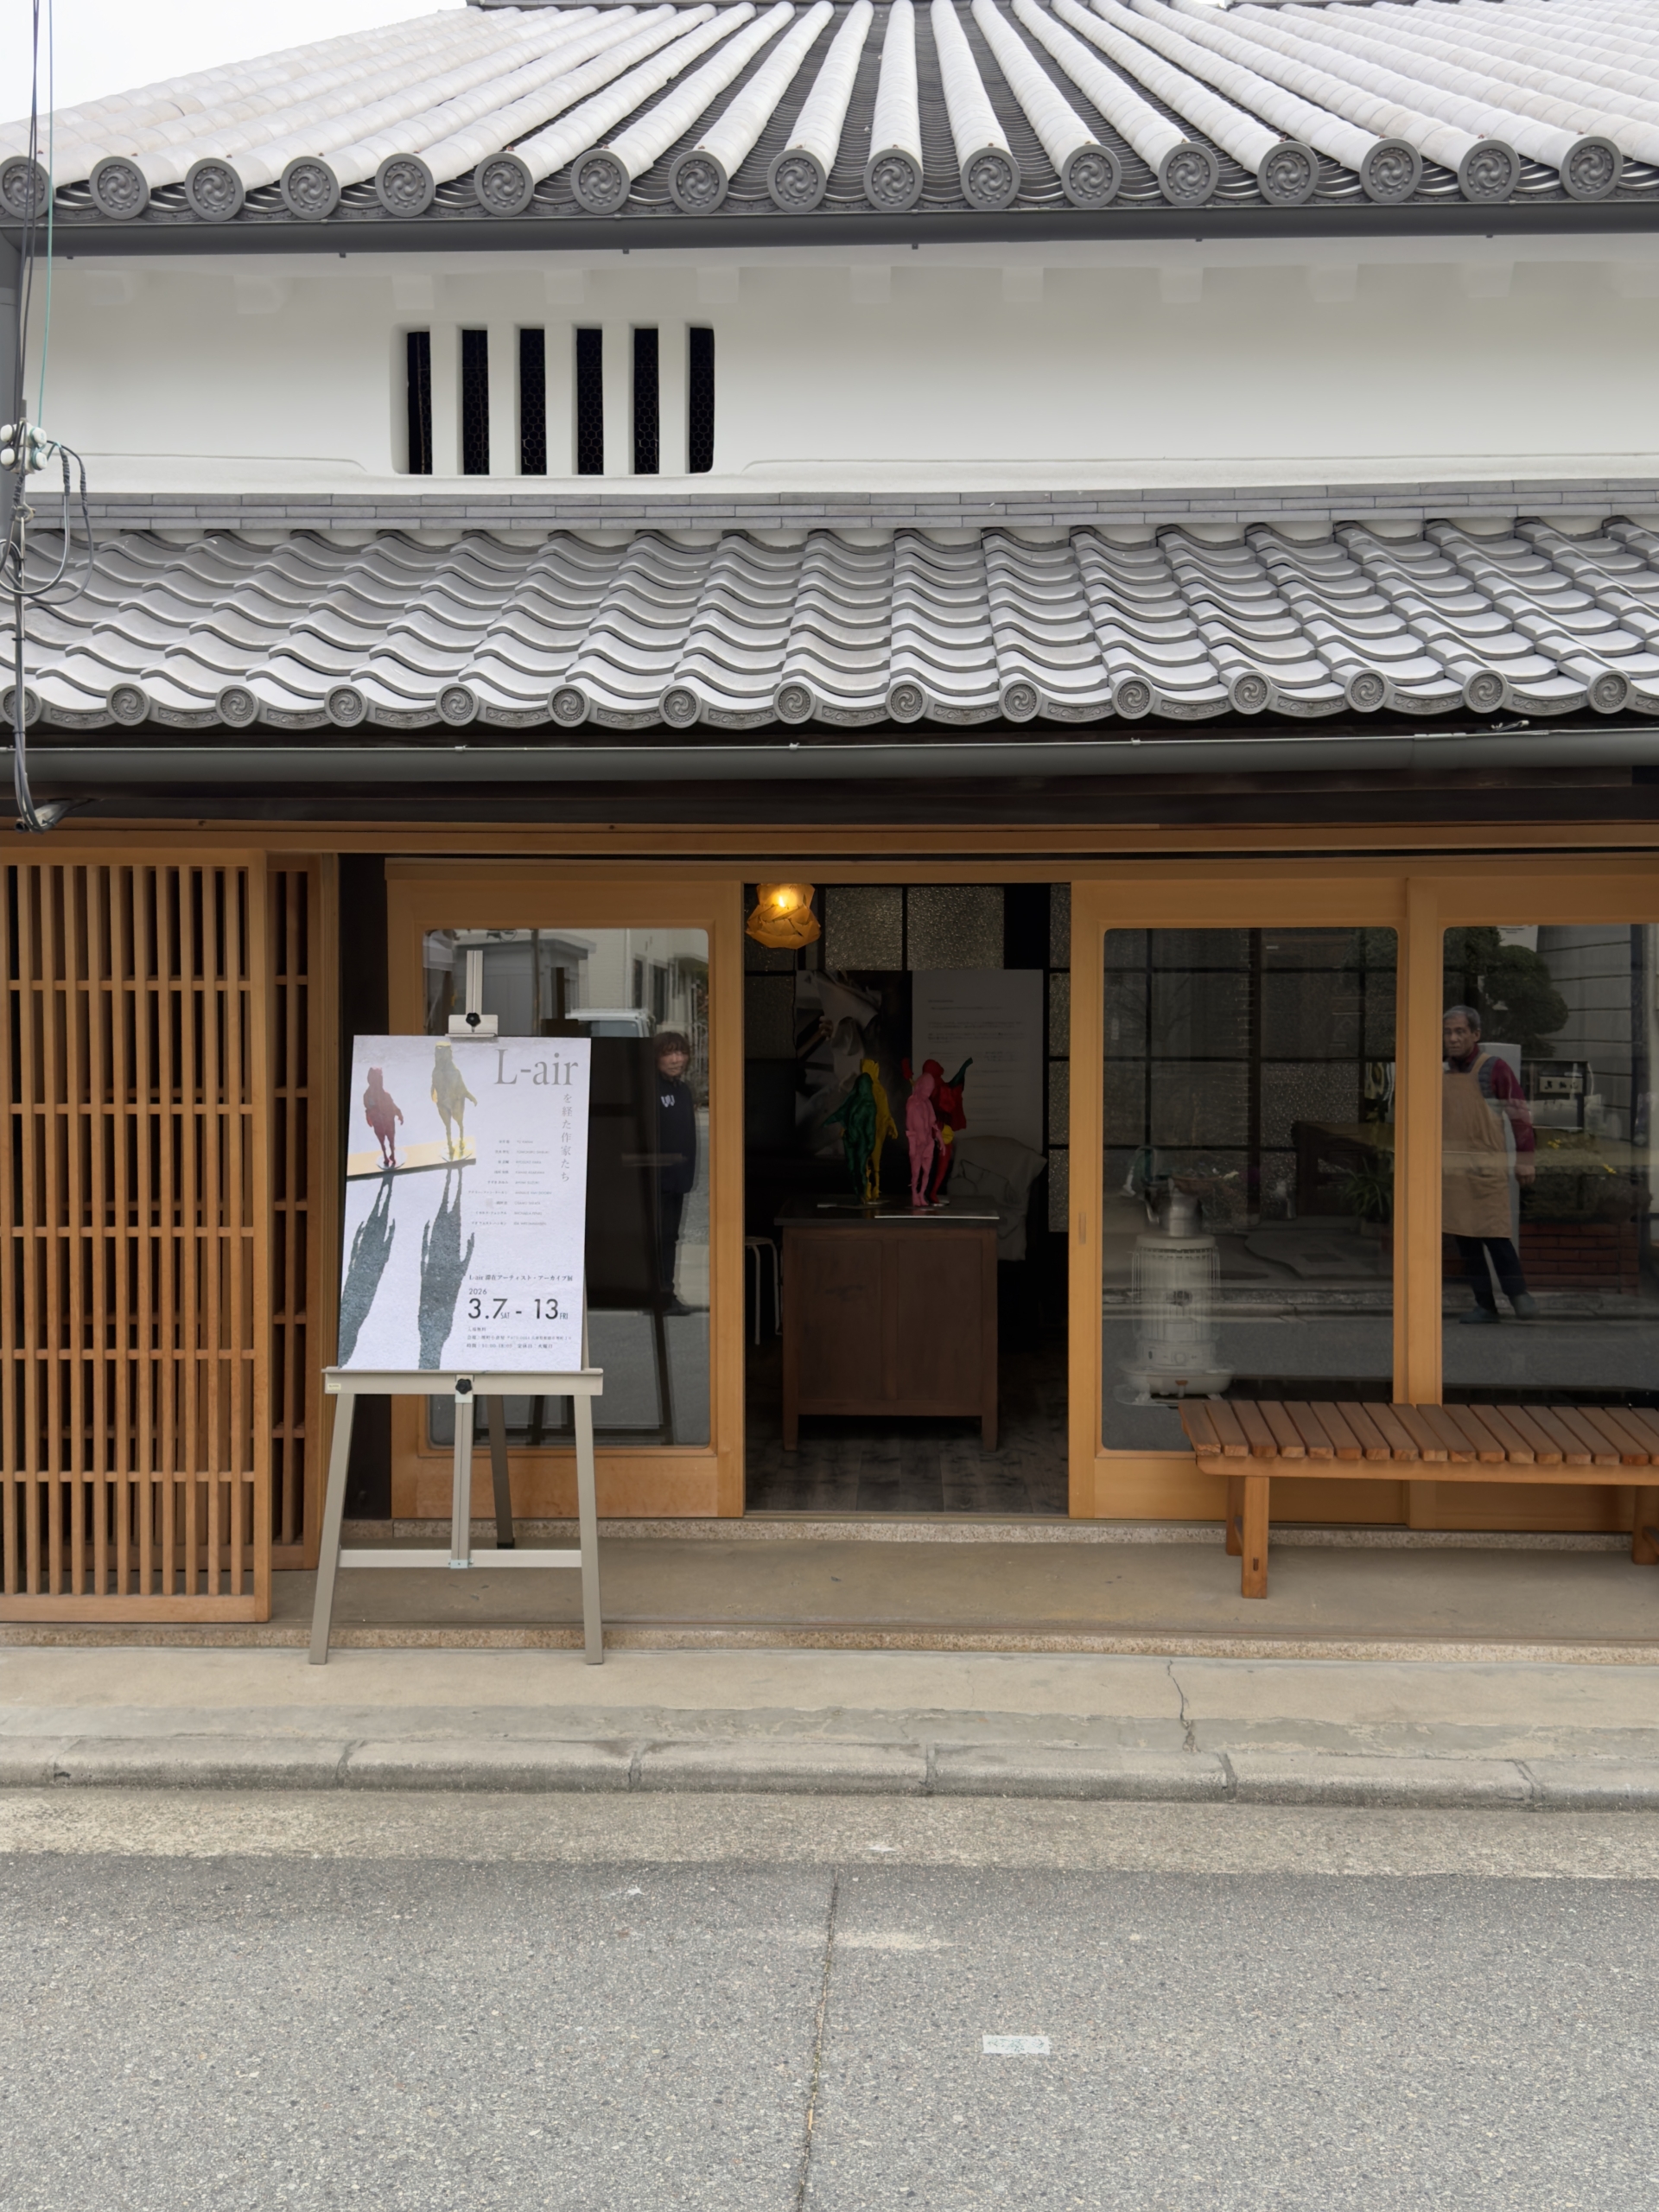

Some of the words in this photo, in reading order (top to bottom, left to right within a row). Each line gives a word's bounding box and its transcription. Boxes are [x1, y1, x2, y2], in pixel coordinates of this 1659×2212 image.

[493, 1048, 579, 1086] L-air
[561, 1093, 573, 1183] を経た作家たち
[467, 1298, 508, 1319] 3.7
[534, 1298, 559, 1319] 13
